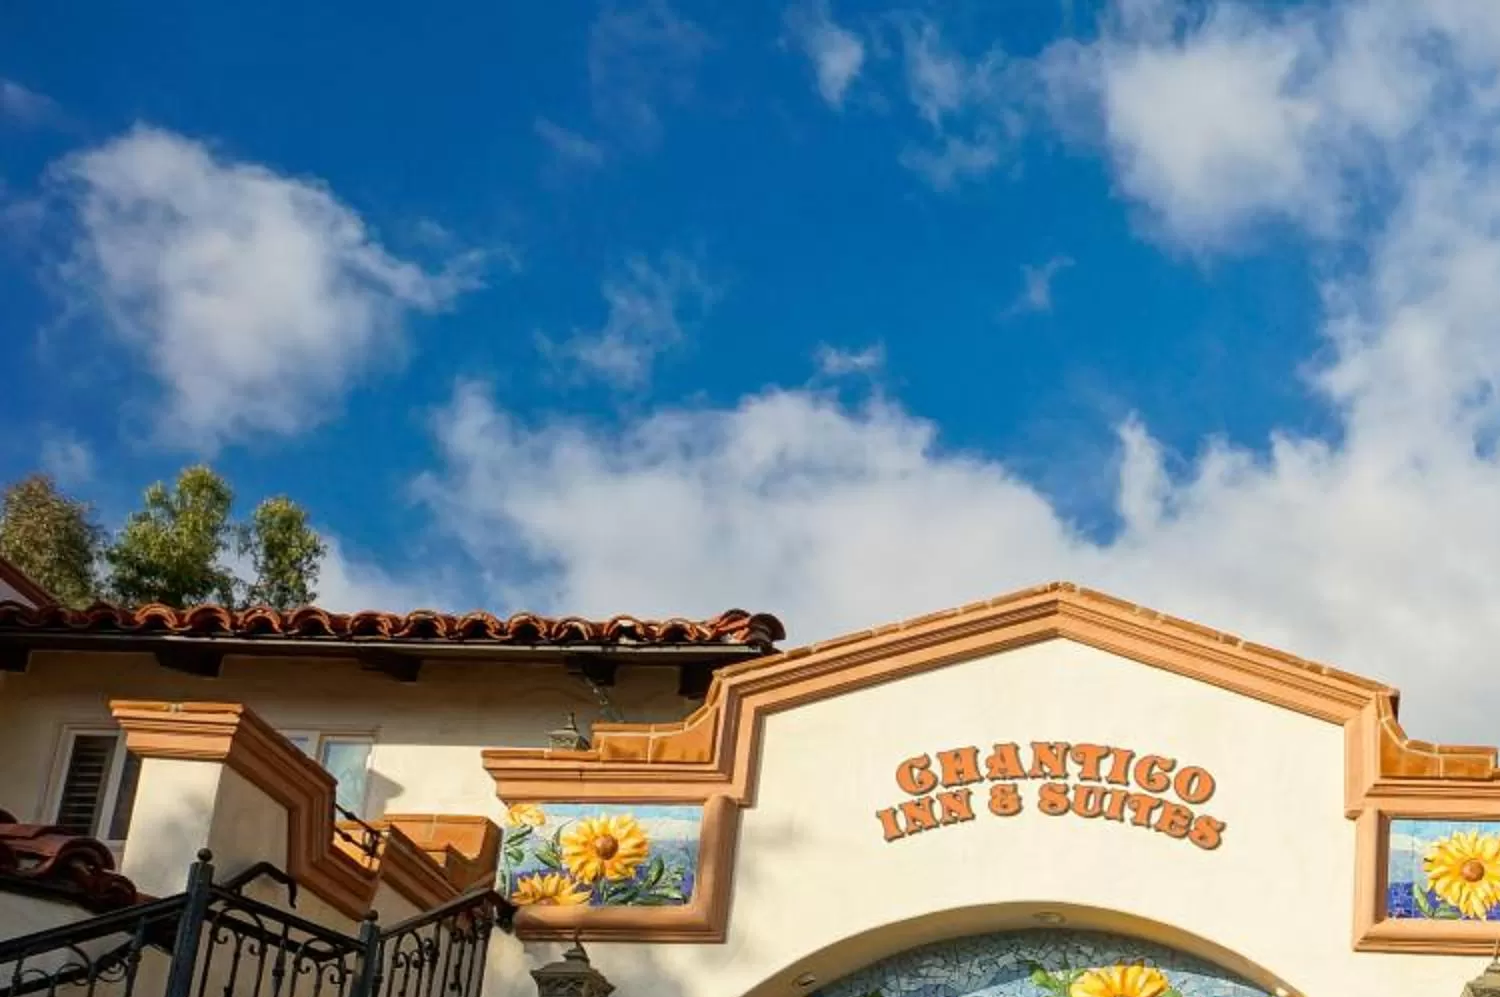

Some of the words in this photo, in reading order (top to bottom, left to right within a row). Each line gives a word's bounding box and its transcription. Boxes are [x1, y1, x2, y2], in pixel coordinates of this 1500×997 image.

[875, 788, 977, 842] INN
[988, 783, 1022, 817] &
[1037, 782, 1227, 851] SUITES
